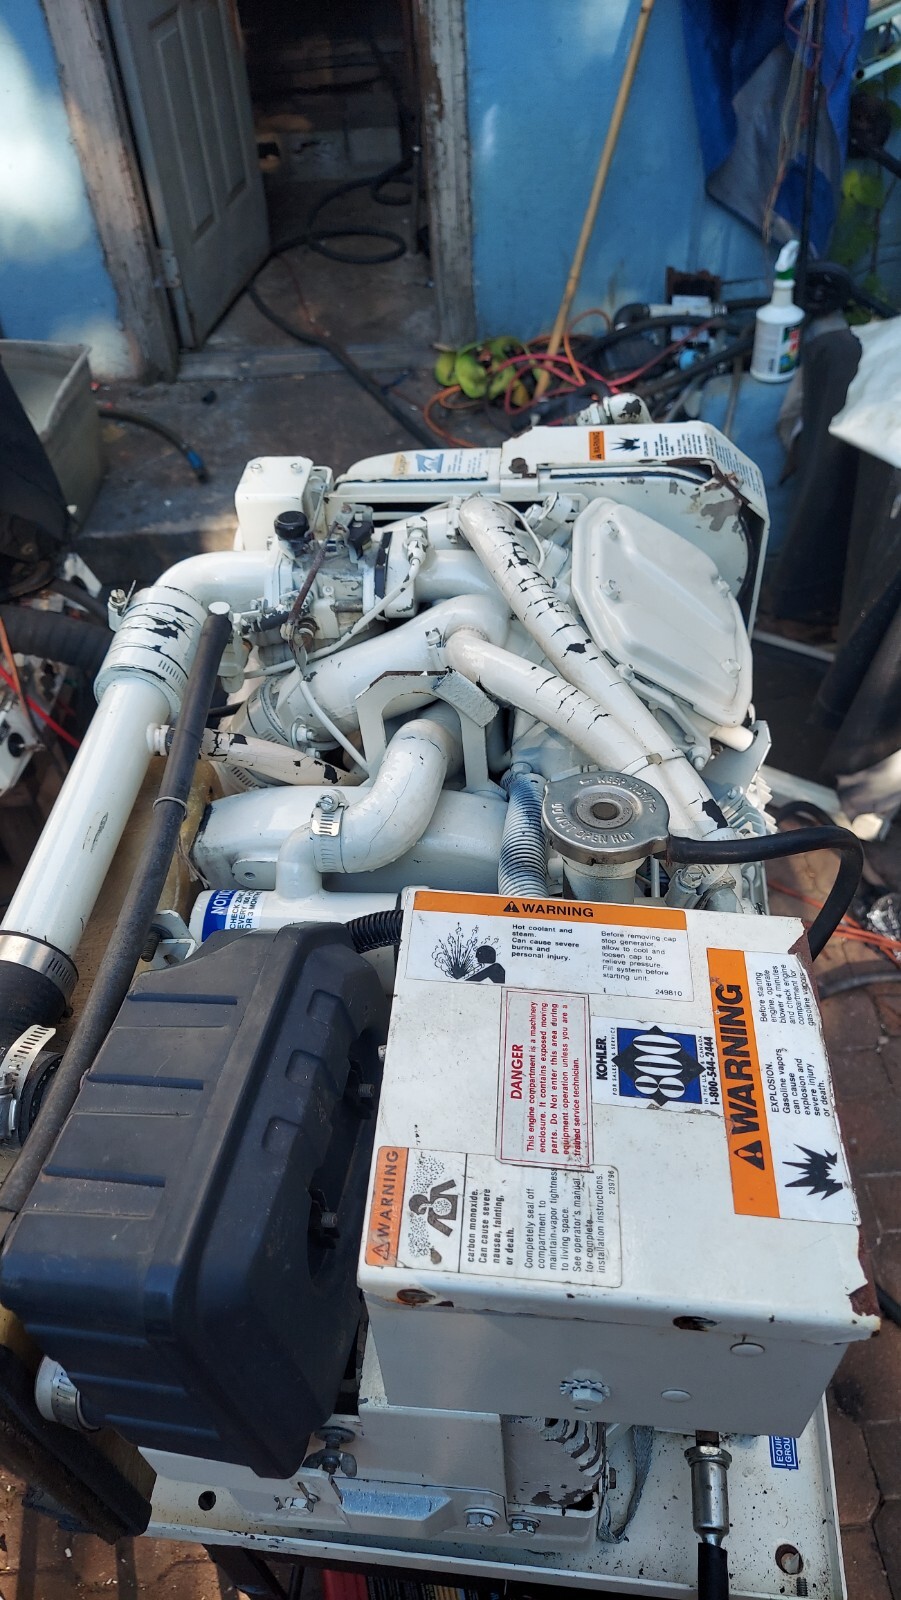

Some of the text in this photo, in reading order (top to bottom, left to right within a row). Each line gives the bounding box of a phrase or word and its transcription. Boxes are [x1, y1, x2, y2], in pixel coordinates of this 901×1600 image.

[575, 830, 608, 844] OPEN
[230, 904, 240, 929] CHECK
[237, 906, 247, 928] EVERY
[522, 903, 593, 917] WARNING
[628, 933, 660, 941] removing
[755, 972, 767, 1022] Before starting
[764, 970, 773, 995] operate
[772, 966, 781, 991] minutes
[781, 965, 795, 1024] and check engine
[529, 1002, 538, 1036] machinery
[778, 1001, 786, 1023] blower
[791, 981, 804, 1025] compartment
[804, 998, 816, 1026] gasoline
[510, 1044, 523, 1100] DANGER
[632, 1034, 685, 1098] 800
[704, 1037, 720, 1105] 1-800-544-2444
[714, 984, 760, 1135] WARNING
[561, 1072, 570, 1109] operation
[765, 1062, 779, 1112] EXPLOSION.
[776, 1049, 790, 1113] Gasoline vapors
[789, 1073, 797, 1096] cause
[794, 1058, 811, 1115] explosion and
[806, 1064, 820, 1116] severe injury
[818, 1080, 830, 1117] or death.
[527, 1107, 536, 1132] engine
[550, 1114, 557, 1125] Do
[561, 1113, 570, 1155] equipment
[527, 1136, 535, 1151] This
[550, 1130, 559, 1154] parts.
[376, 1150, 398, 1238] WARNING
[550, 1168, 559, 1204] tightness
[467, 1189, 478, 1262] carbon monoxide.
[524, 1188, 535, 1268] Completely seal off
[538, 1213, 547, 1269] compartment
[572, 1210, 582, 1253] operator's
[585, 1220, 594, 1258] complete
[478, 1248, 487, 1263] Can
[493, 1231, 502, 1263] nausea,
[505, 1228, 514, 1265] or death.
[561, 1236, 570, 1260] living
[572, 1256, 581, 1272] See
[596, 1226, 605, 1273] installation
